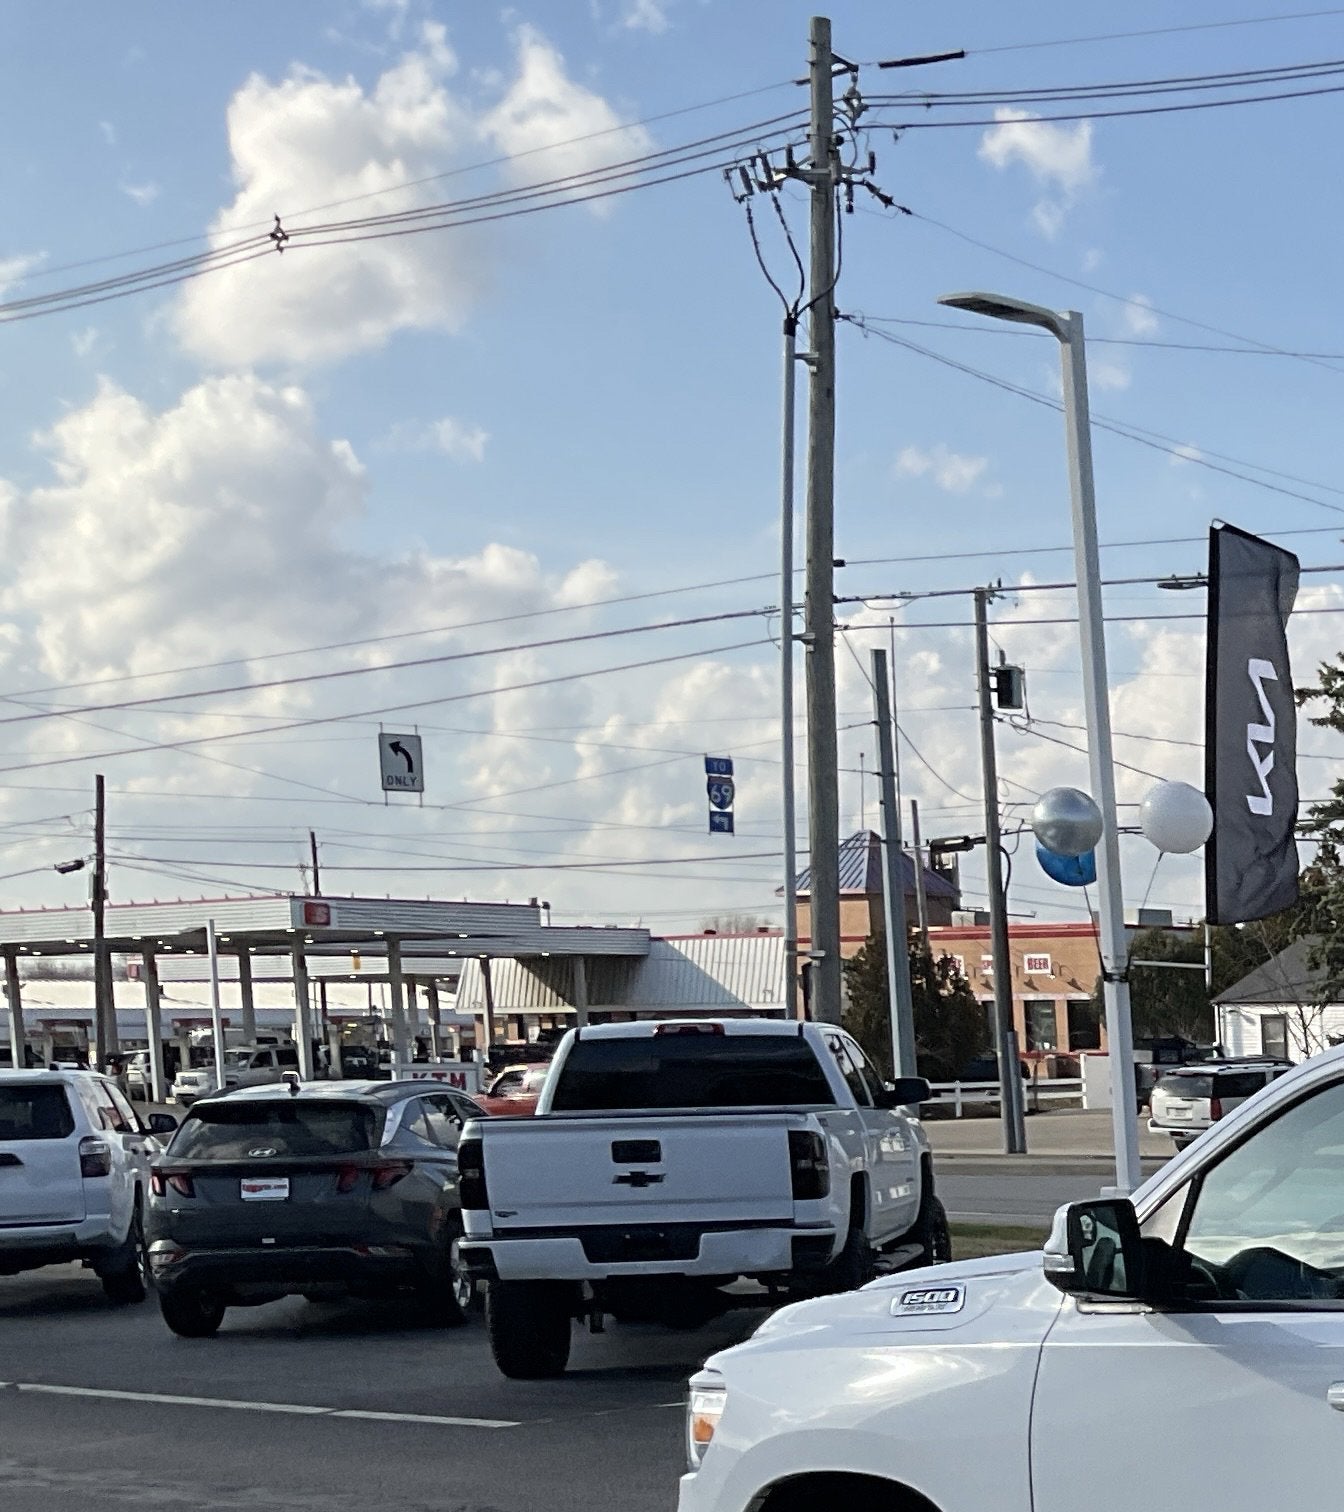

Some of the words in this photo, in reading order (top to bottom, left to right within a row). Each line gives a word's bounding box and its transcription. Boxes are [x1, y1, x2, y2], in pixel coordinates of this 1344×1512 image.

[1246, 658, 1278, 816] KIA
[712, 761, 726, 771] TO
[386, 774, 417, 787] ONLY
[710, 784, 733, 803] 69
[903, 1289, 957, 1304] 1500
